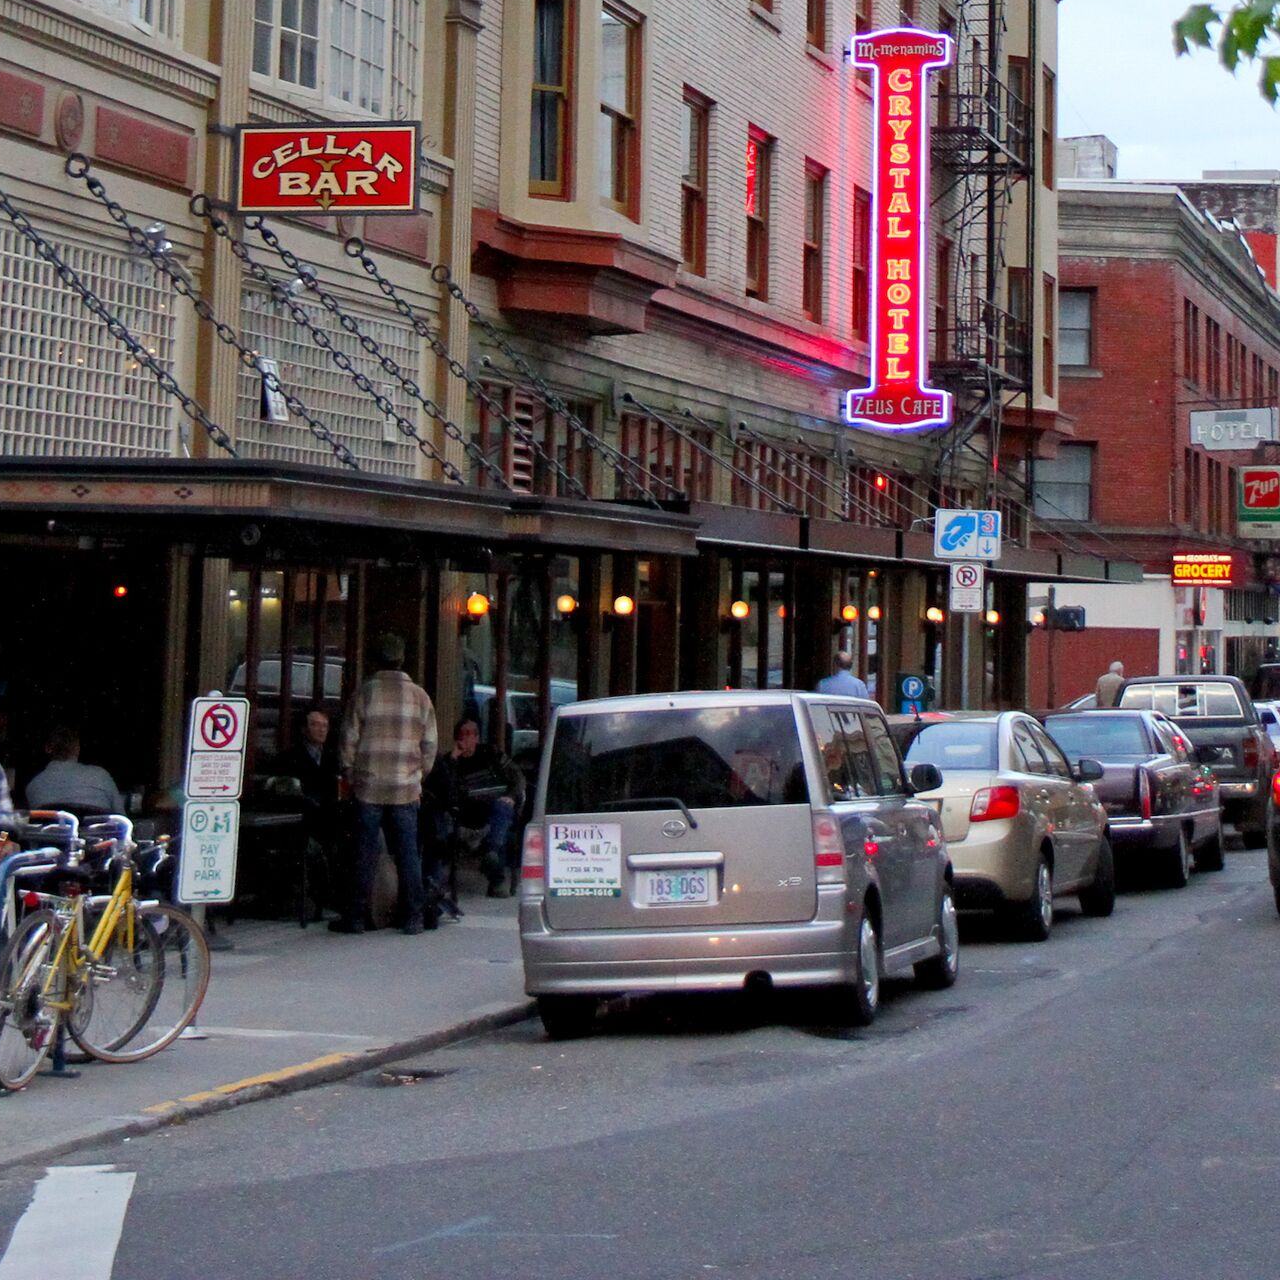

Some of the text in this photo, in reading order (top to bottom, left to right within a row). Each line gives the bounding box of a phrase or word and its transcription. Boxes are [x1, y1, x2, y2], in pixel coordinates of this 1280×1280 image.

[251, 134, 404, 182] CELLAR
[887, 68, 913, 239] CRYSTAL
[278, 170, 379, 196] BAR
[886, 259, 912, 380] HOTEL
[1196, 422, 1266, 441] HOTEL
[1173, 563, 1231, 578] GROCERY
[200, 843, 219, 855] PAY
[202, 857, 216, 868] TO
[194, 870, 222, 881] PARK
[649, 876, 705, 896] 183 DGS
